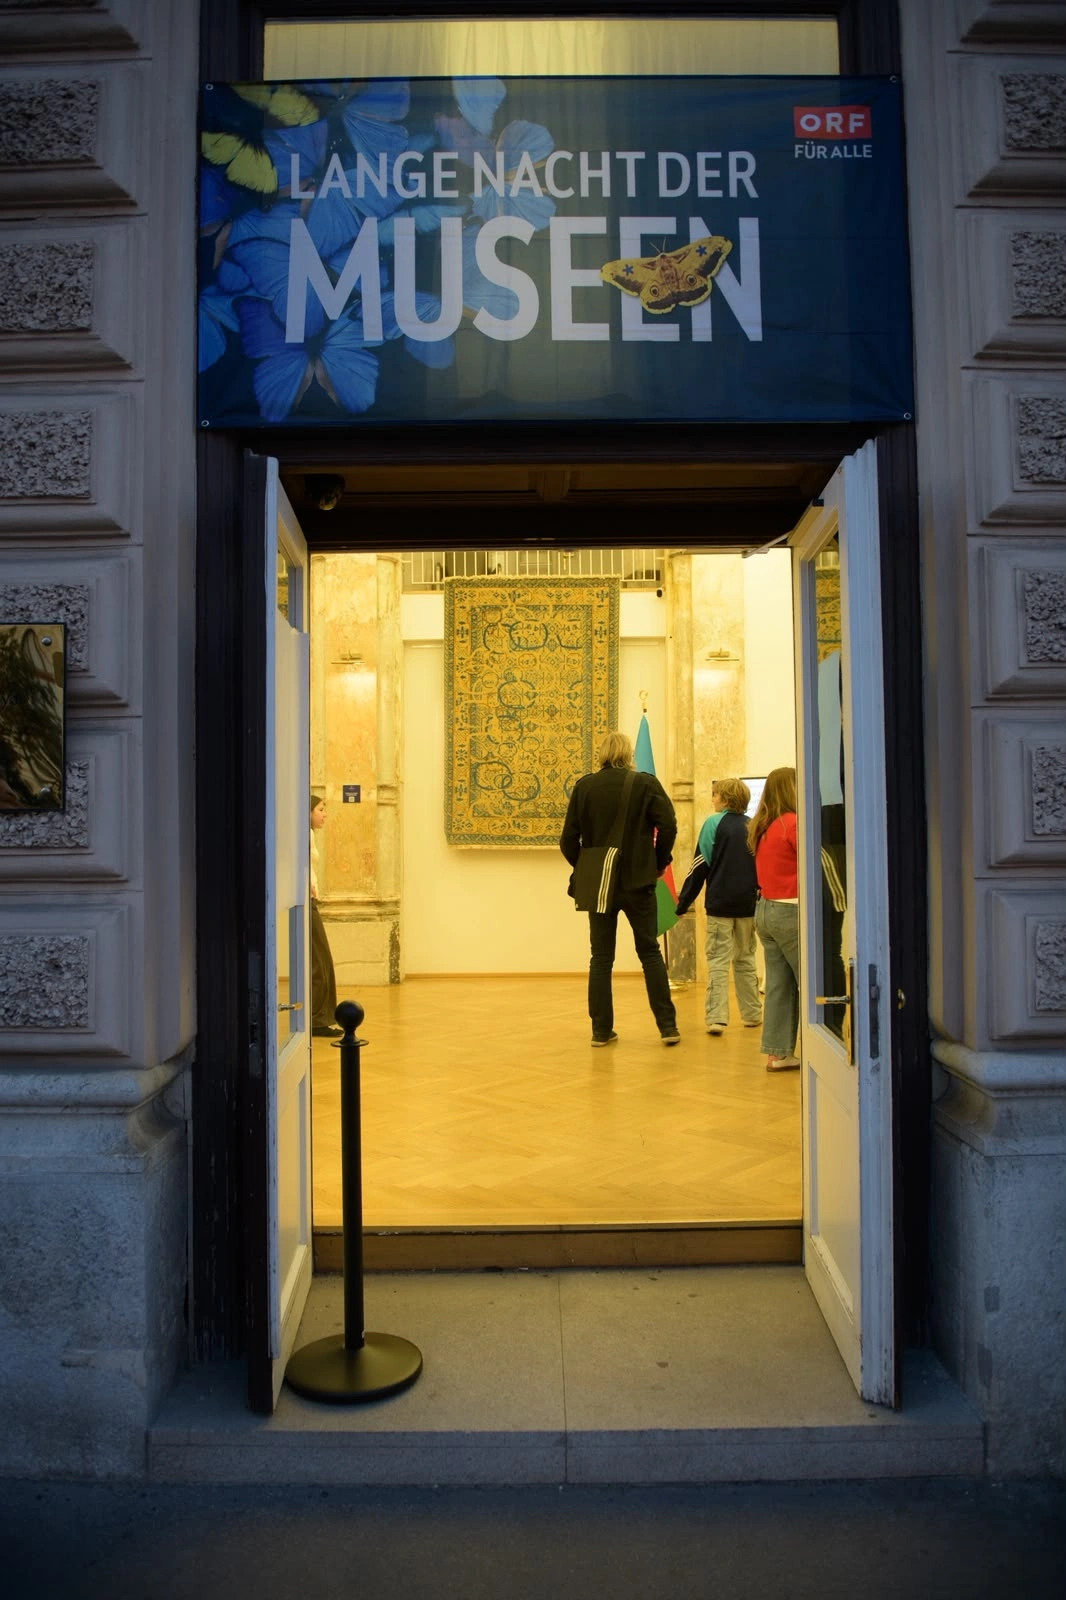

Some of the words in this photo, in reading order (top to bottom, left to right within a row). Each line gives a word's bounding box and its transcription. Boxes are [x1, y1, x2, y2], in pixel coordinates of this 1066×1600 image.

[799, 112, 865, 134] ORF
[794, 140, 828, 160] FÜR
[830, 144, 873, 159] ALLE
[290, 151, 459, 199] LANGE
[473, 150, 646, 198] NACHT
[657, 150, 760, 199] DER
[285, 215, 763, 343] MUSEEN
